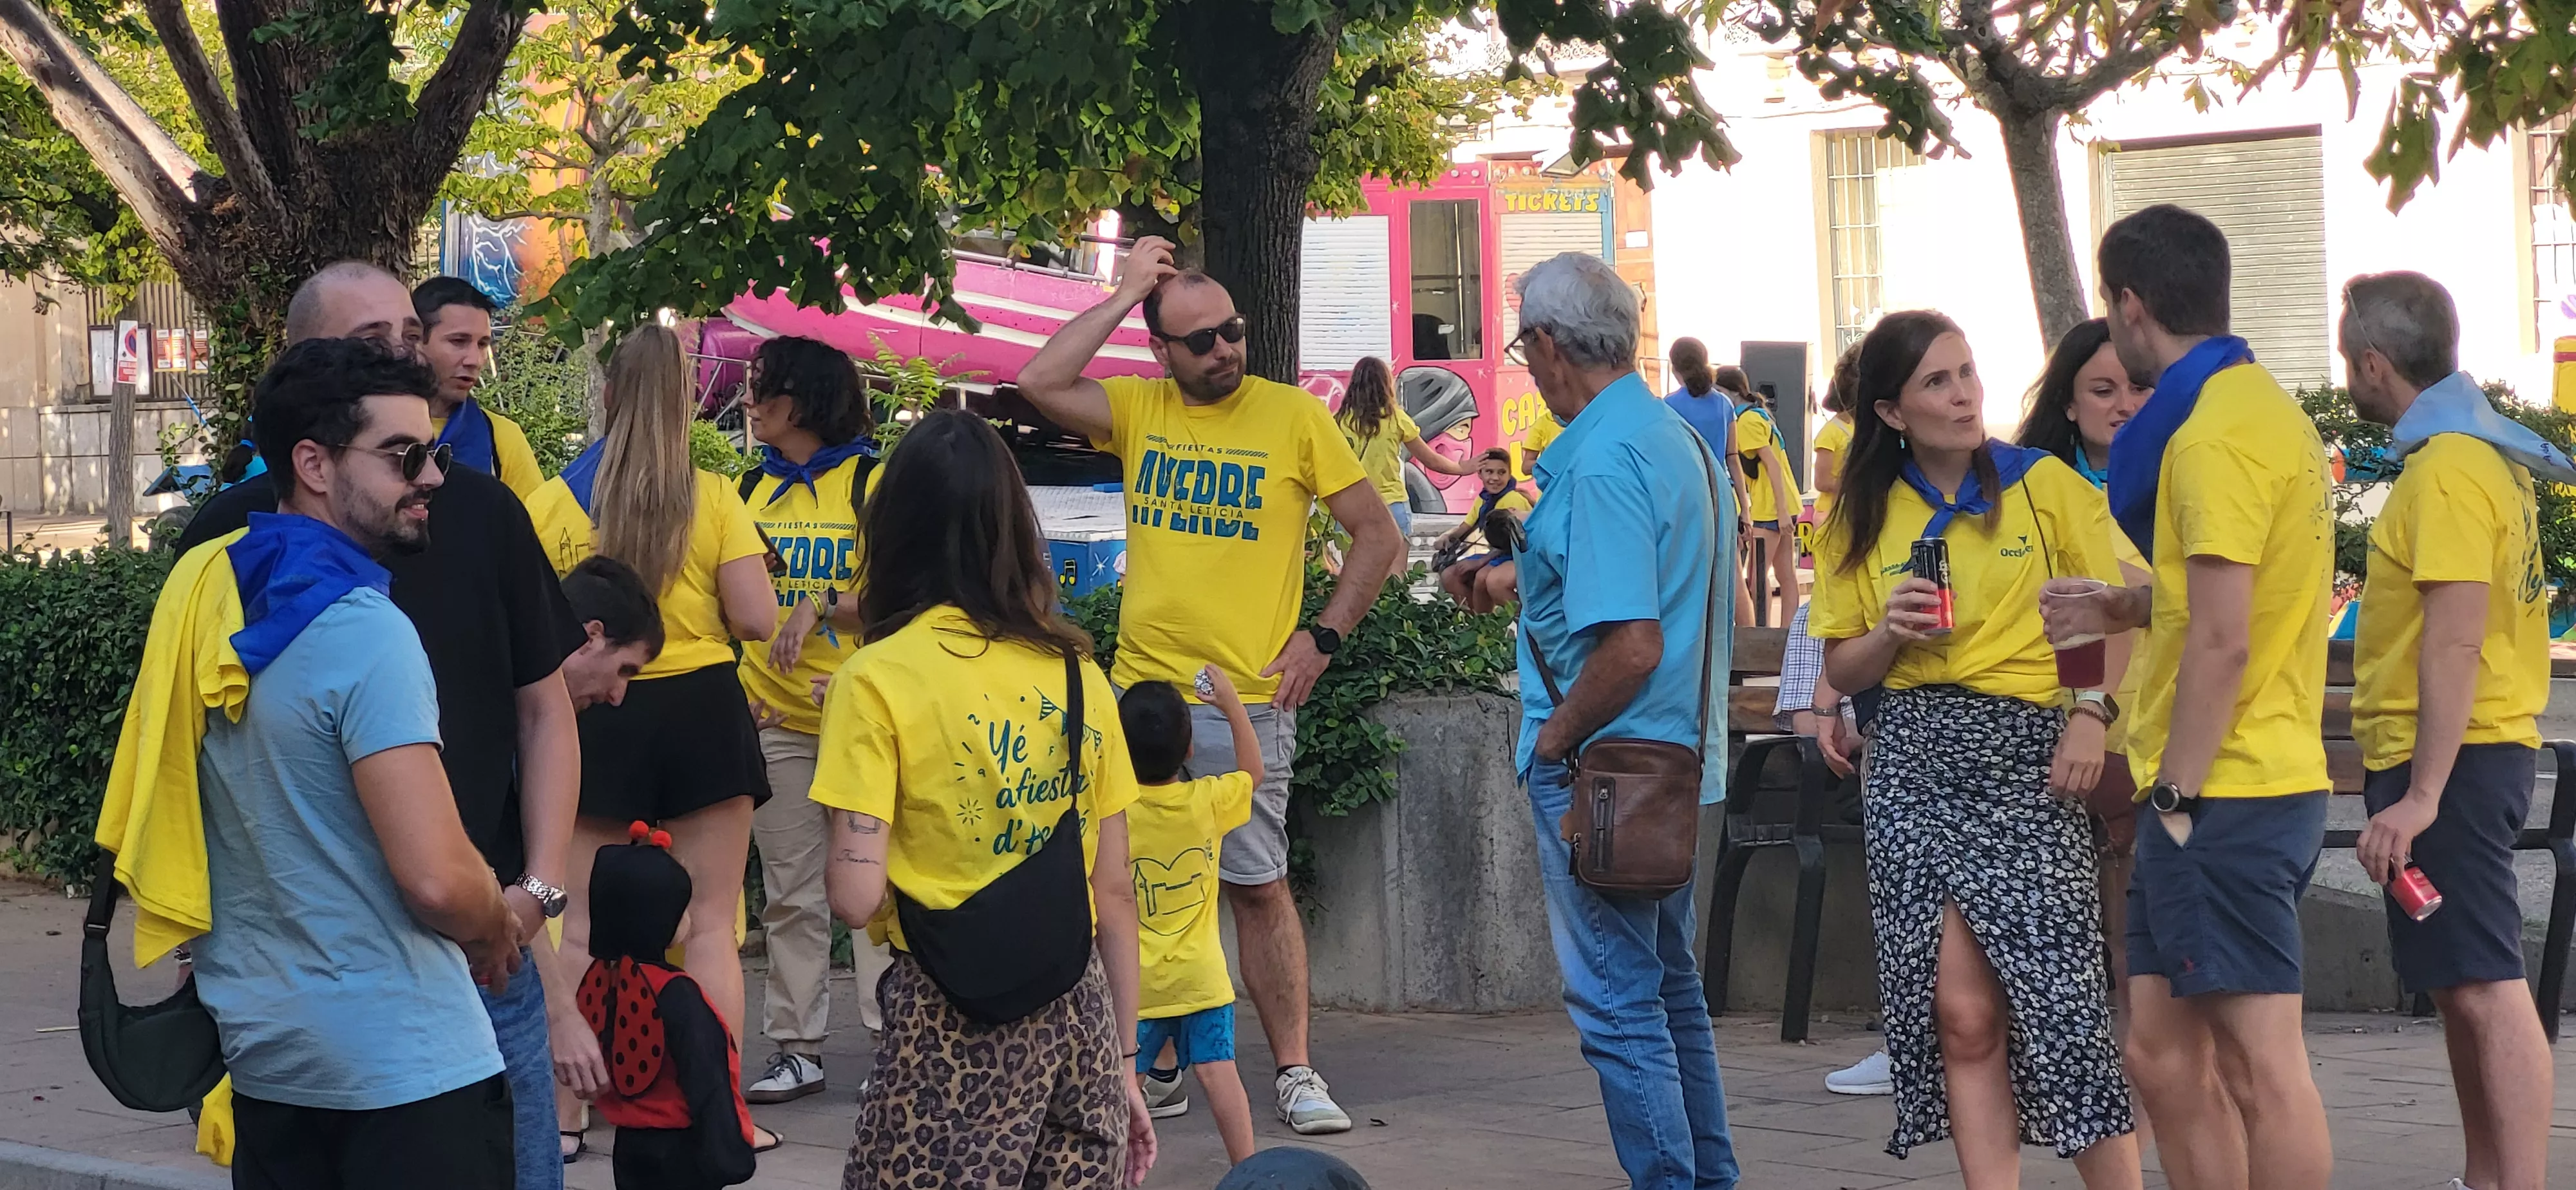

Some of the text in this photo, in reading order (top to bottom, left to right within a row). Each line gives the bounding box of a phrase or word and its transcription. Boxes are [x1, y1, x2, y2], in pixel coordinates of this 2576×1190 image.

[1504, 192, 1599, 212] TICKETS
[1176, 444, 1223, 454] FIESTAS
[1144, 496, 1244, 519] SANTA LETICIA
[989, 719, 1028, 775] Yé
